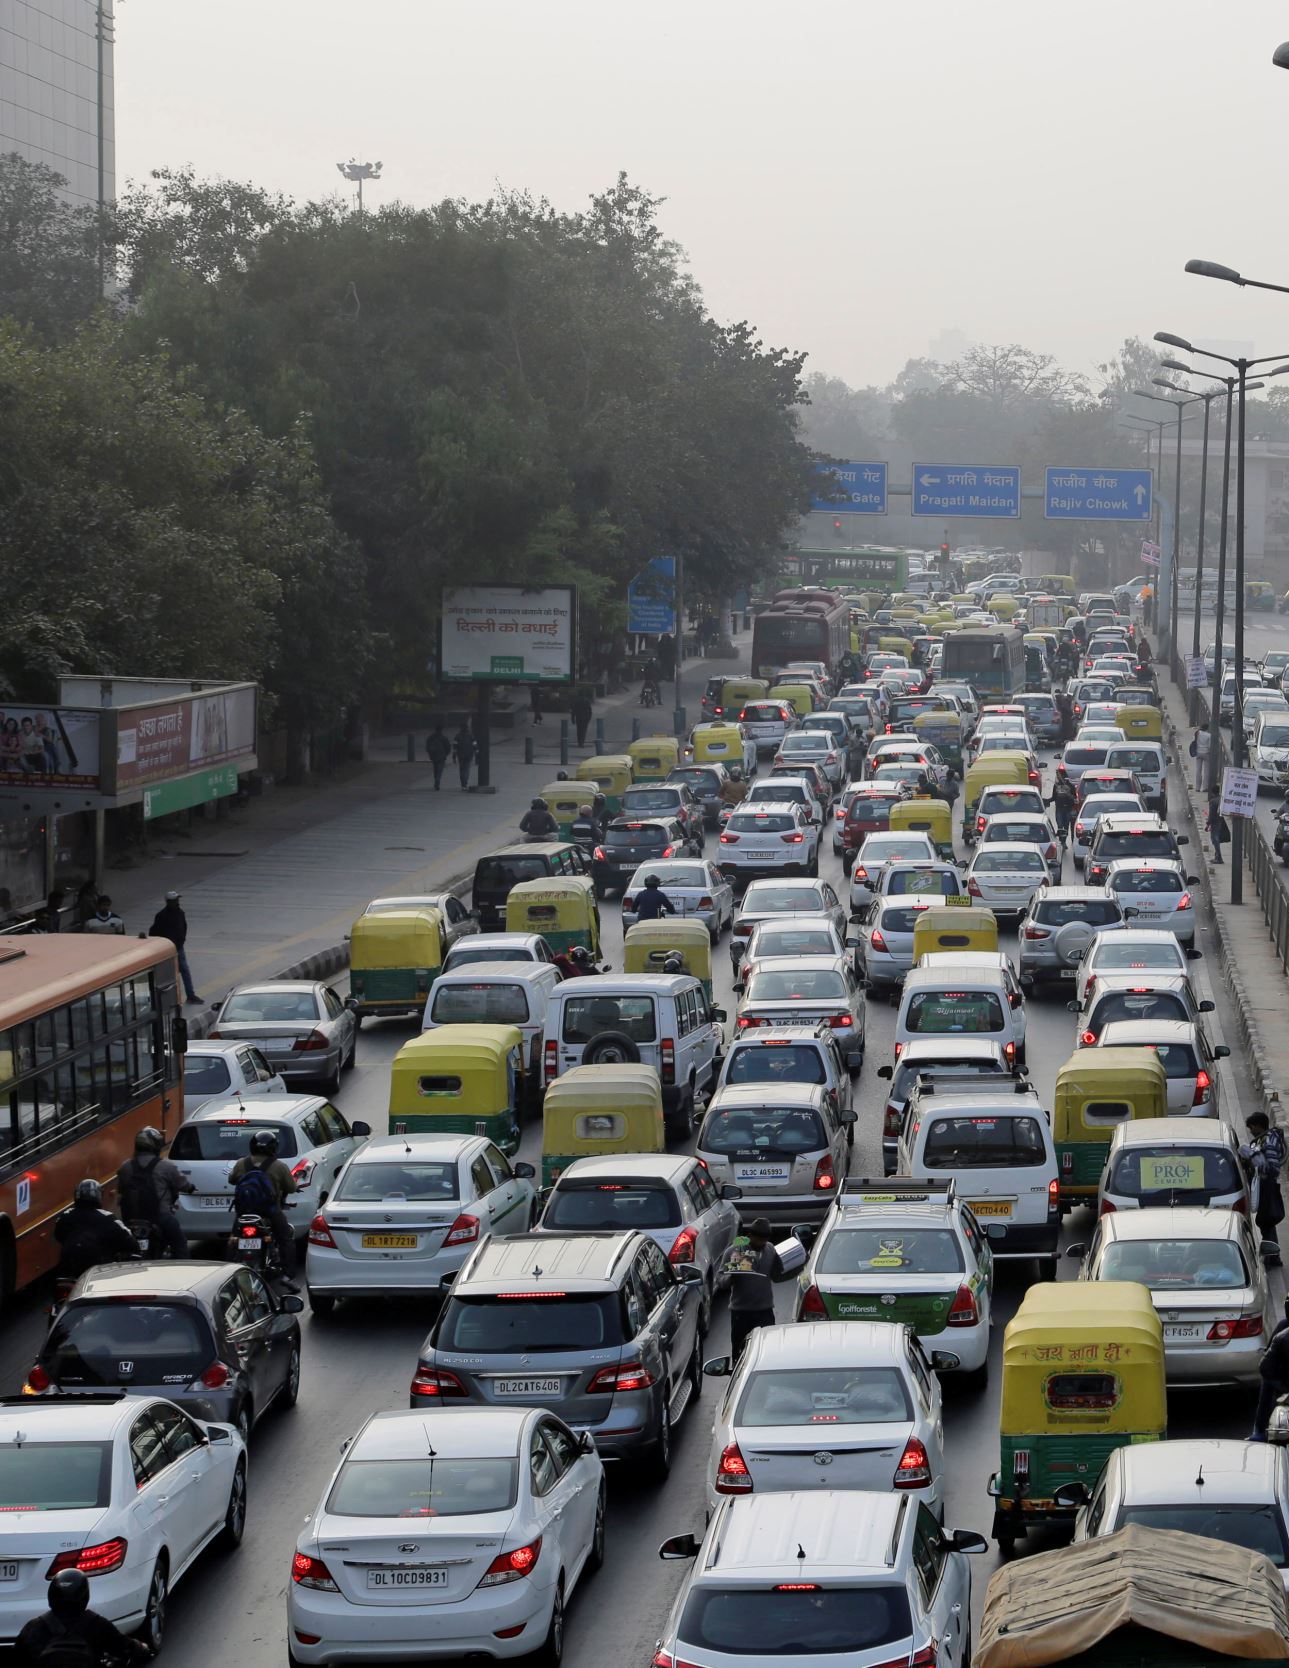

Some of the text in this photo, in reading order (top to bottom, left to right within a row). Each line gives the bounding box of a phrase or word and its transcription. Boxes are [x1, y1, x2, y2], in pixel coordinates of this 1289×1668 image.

[946, 471, 1014, 487] प्रगति मैदान
[1051, 473, 1119, 489] राजीव चौक
[852, 492, 881, 503] Gate
[920, 494, 1014, 507] Pragati Maidan
[1050, 497, 1128, 510] Rajiv Chowk
[456, 617, 559, 636] दिल्ली को बधाई
[138, 706, 183, 738] अच्छा लगता है
[971, 1206, 1009, 1215] 16CT0440
[367, 1237, 416, 1246] DL1RT7218
[1036, 1343, 1121, 1362] जय माता दी
[500, 1381, 559, 1392] DL2CAT6406
